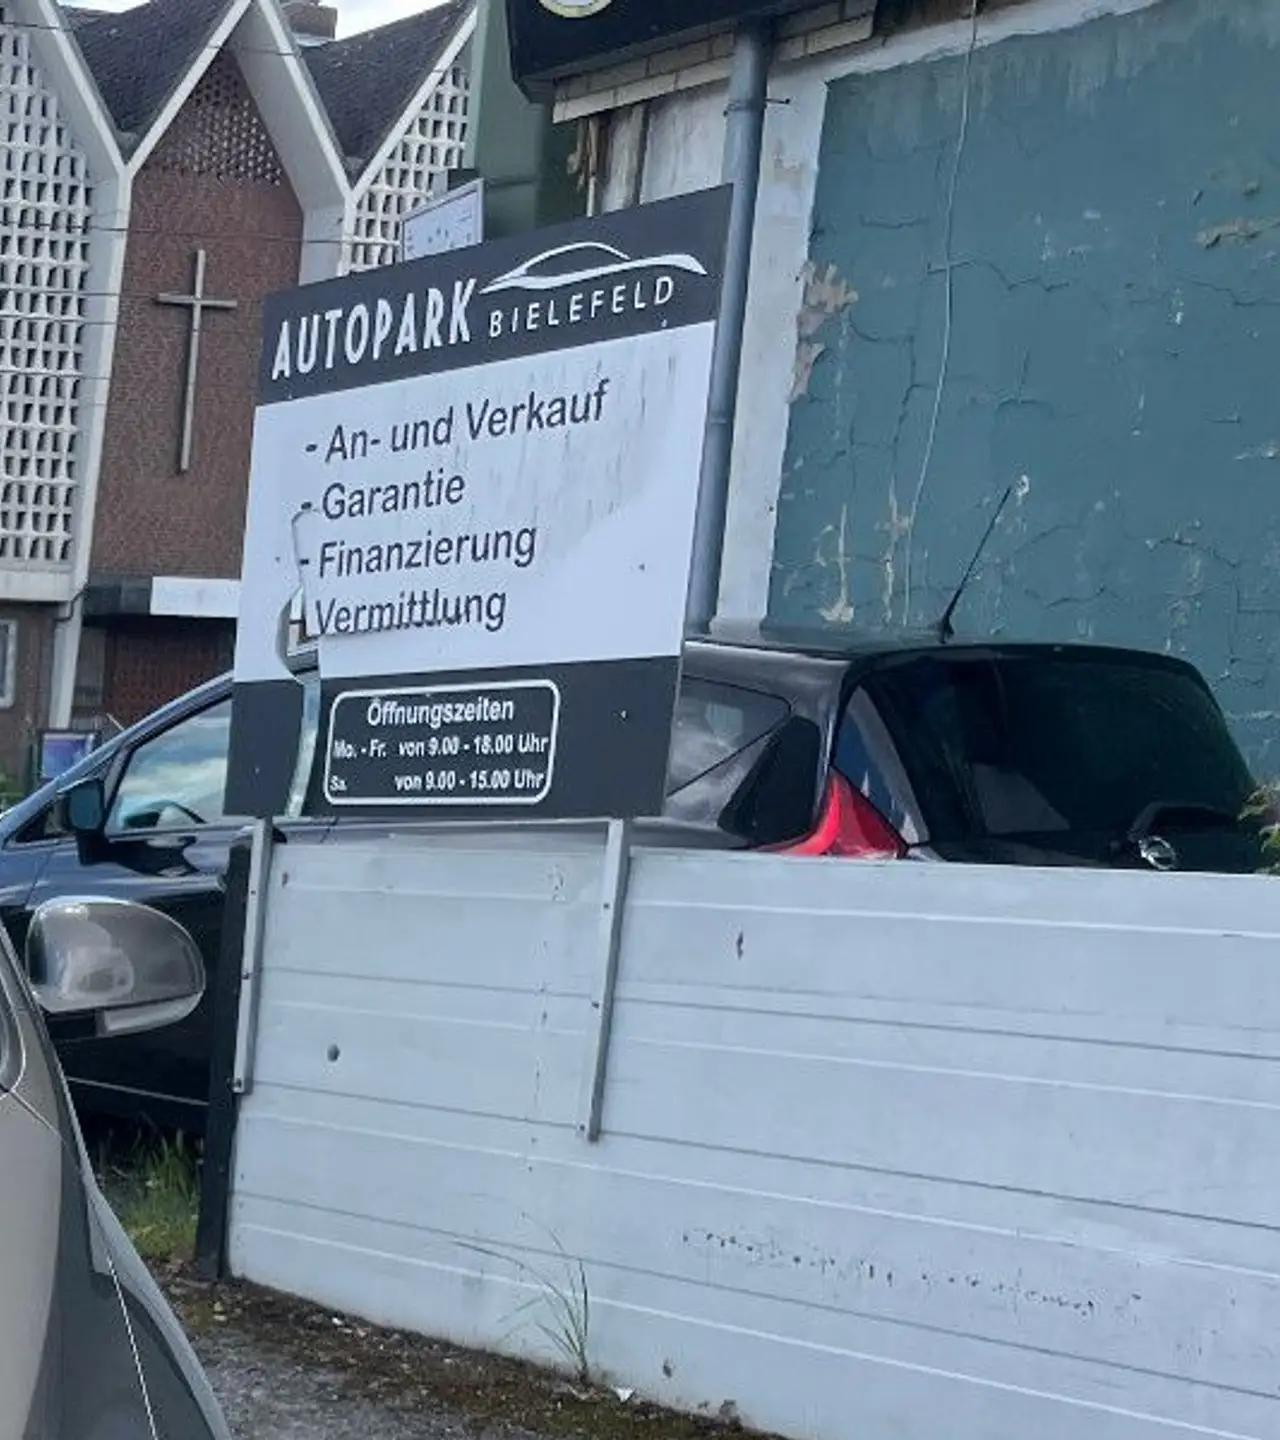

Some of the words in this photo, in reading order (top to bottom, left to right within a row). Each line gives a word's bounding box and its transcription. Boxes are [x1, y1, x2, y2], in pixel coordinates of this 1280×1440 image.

[271, 278, 477, 380] AUTOPARK
[487, 275, 675, 338] BIELEFELD
[324, 424, 382, 464] An-
[390, 405, 454, 453] und
[465, 378, 611, 441] Verkauf
[321, 467, 466, 521] Garantie
[318, 527, 537, 578] Finanzierung
[315, 588, 507, 635] Vermittlung
[366, 696, 514, 729] Öffnungszeiten
[369, 738, 387, 758] Fr.
[398, 741, 426, 758] von
[427, 736, 460, 757] 9.00
[473, 735, 514, 756] 18.00
[517, 732, 549, 753] Uhr
[394, 774, 422, 792] von
[425, 770, 456, 790] 9.00
[469, 769, 511, 790] 15.00
[513, 768, 545, 789] Uhr
